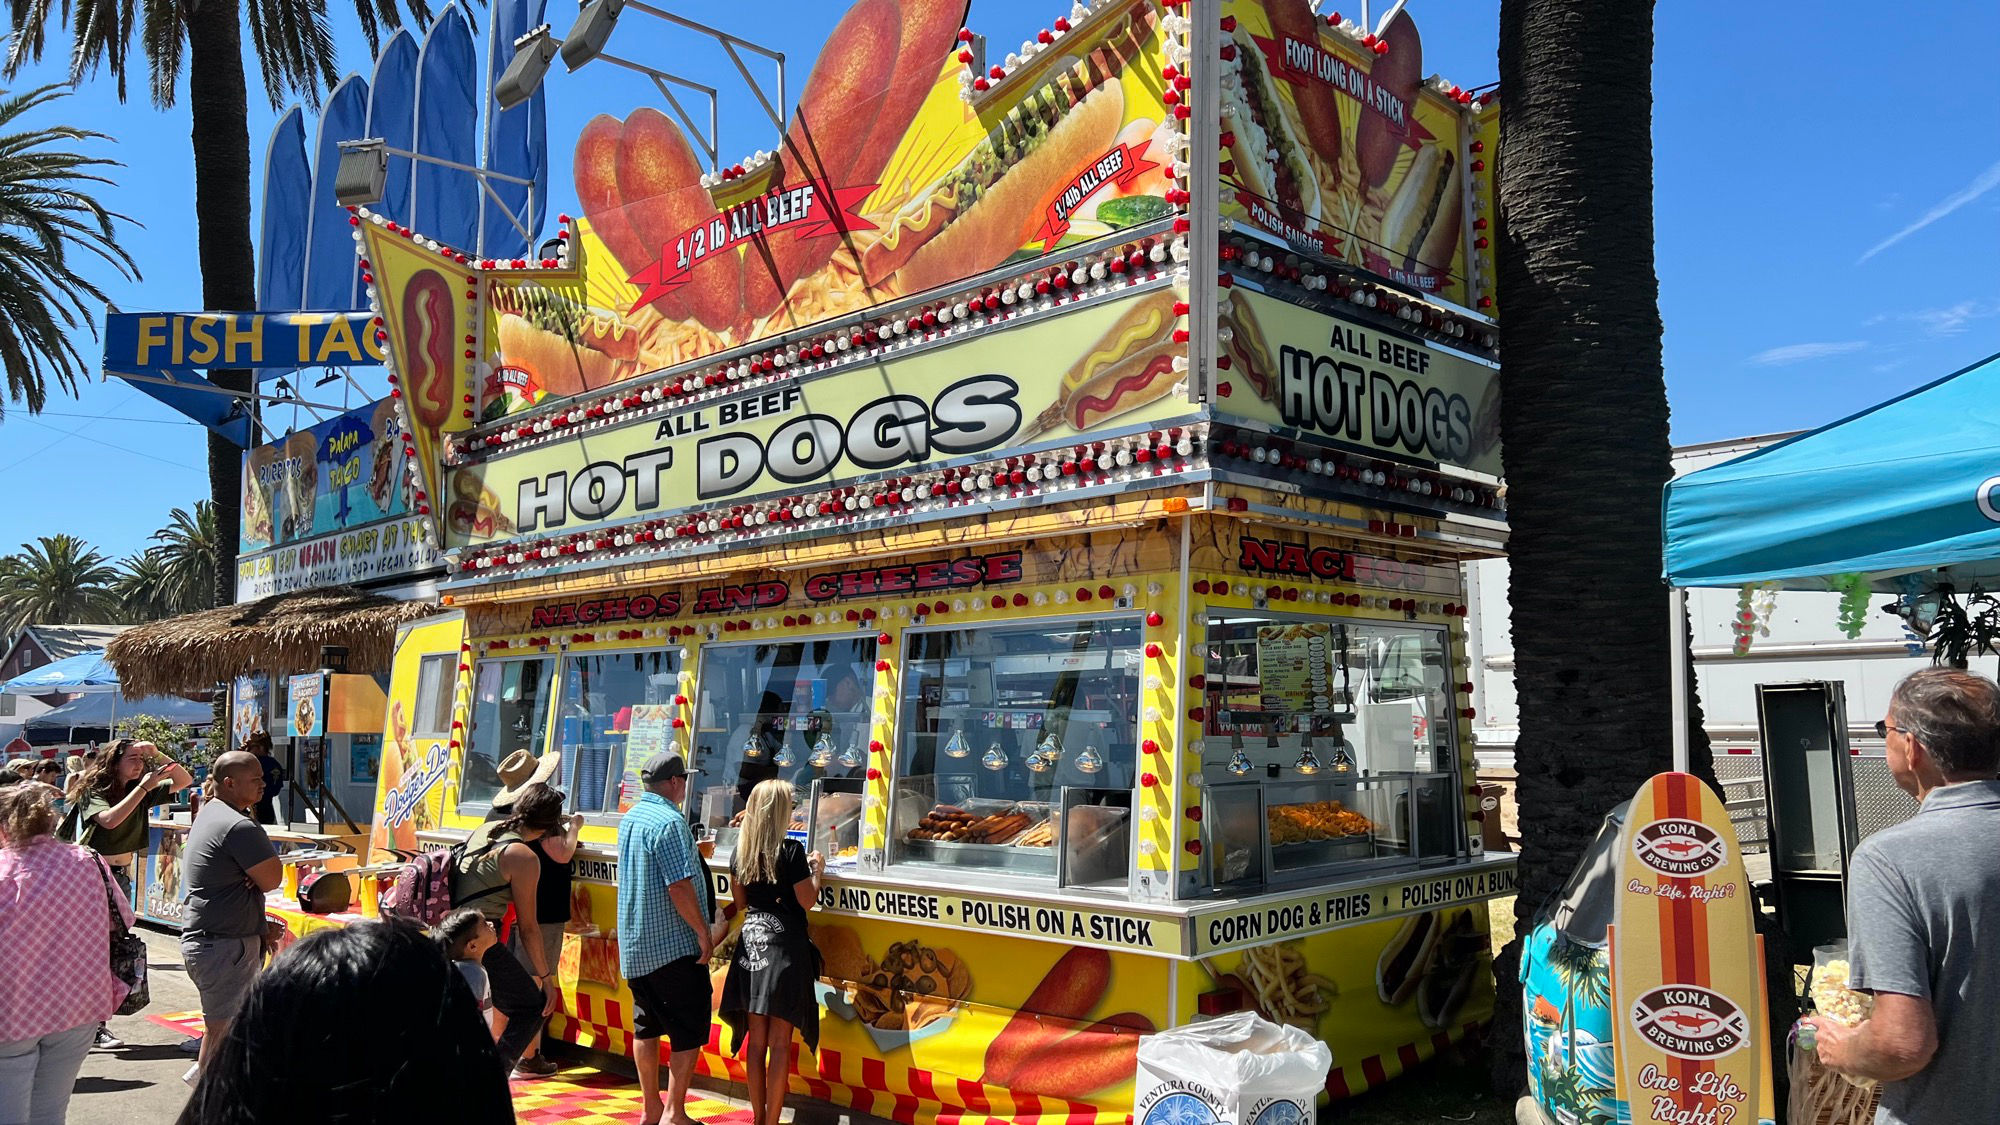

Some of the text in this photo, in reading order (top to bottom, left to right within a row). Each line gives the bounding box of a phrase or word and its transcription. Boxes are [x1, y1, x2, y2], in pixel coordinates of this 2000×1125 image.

[1284, 36, 1407, 127] FOOT LONG ON A STICK
[1054, 149, 1124, 222] 1/4lb ALL BEEF
[676, 186, 814, 272] 1/2 lb ALL BEEF
[1251, 202, 1325, 253] POLISH SAUSAGE
[1407, 273, 1419, 287] ALL
[1419, 275, 1435, 288] BEEF
[137, 315, 264, 365] FISH
[1330, 324, 1430, 374] ALL BEEF
[654, 390, 802, 442] ALL BEEF
[1280, 345, 1472, 466] HOT DOGS
[260, 455, 302, 486] BURRITOS
[329, 456, 361, 489] TACO
[516, 374, 1023, 534] HOT DOGS
[239, 560, 256, 581] YOU
[258, 555, 277, 576] CAN
[278, 549, 296, 573] EAT
[340, 529, 378, 558] SMART
[383, 524, 398, 548] AT
[402, 516, 427, 543] THE
[254, 578, 282, 596] BURRITO
[284, 574, 302, 589] BOWL
[309, 567, 342, 586] SPINACH
[346, 562, 369, 579] WRAP
[376, 556, 404, 573] VEGAN
[531, 550, 1023, 629] NACHOS AND CHEESE
[385, 771, 425, 827] Dodger
[1658, 823, 1697, 837] KONA
[1645, 852, 1699, 873] BREWING
[151, 900, 183, 919] TACOS
[1209, 870, 1514, 947] CORN DOG & FRIES POLISH ON A BUN
[1628, 878, 1735, 904] One Life, Right?
[839, 887, 871, 912] AND
[875, 891, 939, 920] CHEESE
[962, 901, 1031, 931] POLISH
[1036, 907, 1065, 935] ON
[1071, 912, 1085, 938] A
[1089, 914, 1154, 947] STICK
[1663, 991, 1711, 1009] KONA
[1646, 1026, 1714, 1053] BREWING
[1140, 1080, 1226, 1117] VENTURA COUNTY
[1638, 1063, 1747, 1102] One Life,
[1651, 1095, 1737, 1125] Right?
